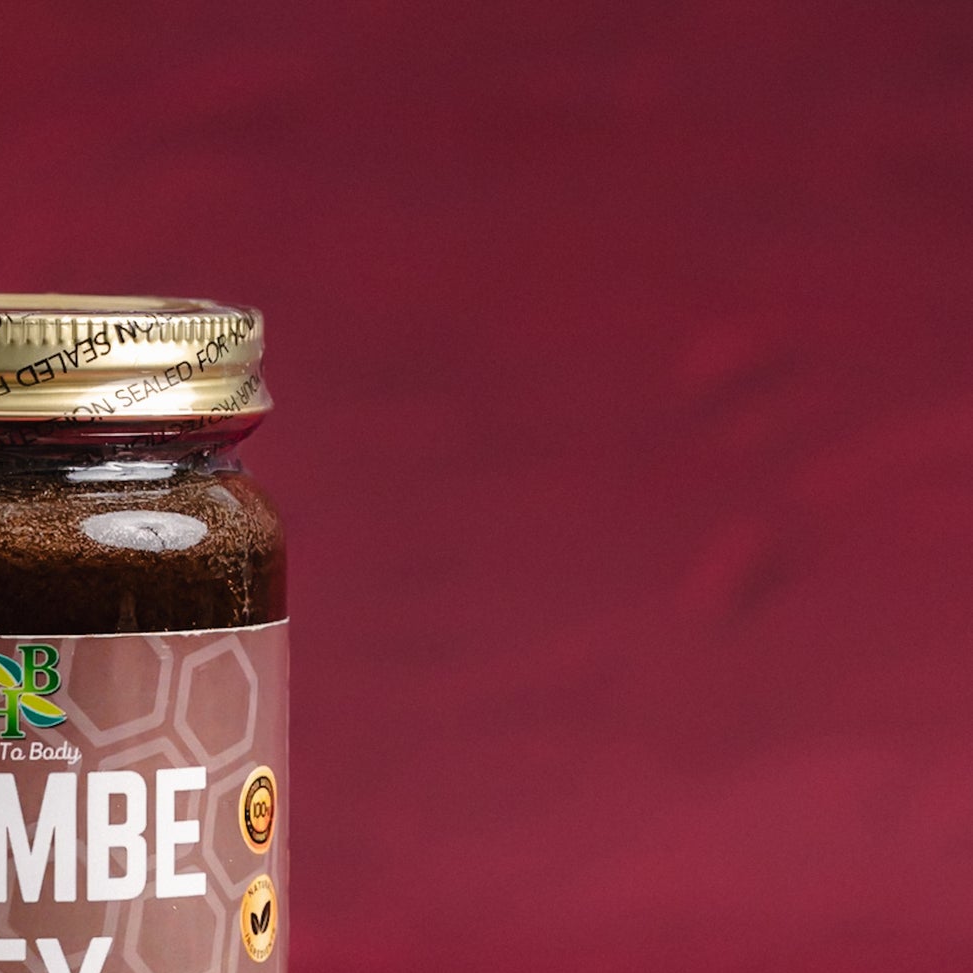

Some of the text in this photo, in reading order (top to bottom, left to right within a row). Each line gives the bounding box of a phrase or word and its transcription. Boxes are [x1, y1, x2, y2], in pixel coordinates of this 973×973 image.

[15, 331, 111, 387] SEALED
[114, 360, 194, 408] SEALED
[196, 333, 229, 372] FOR
[0, 742, 26, 761] To
[29, 740, 83, 765] Body
